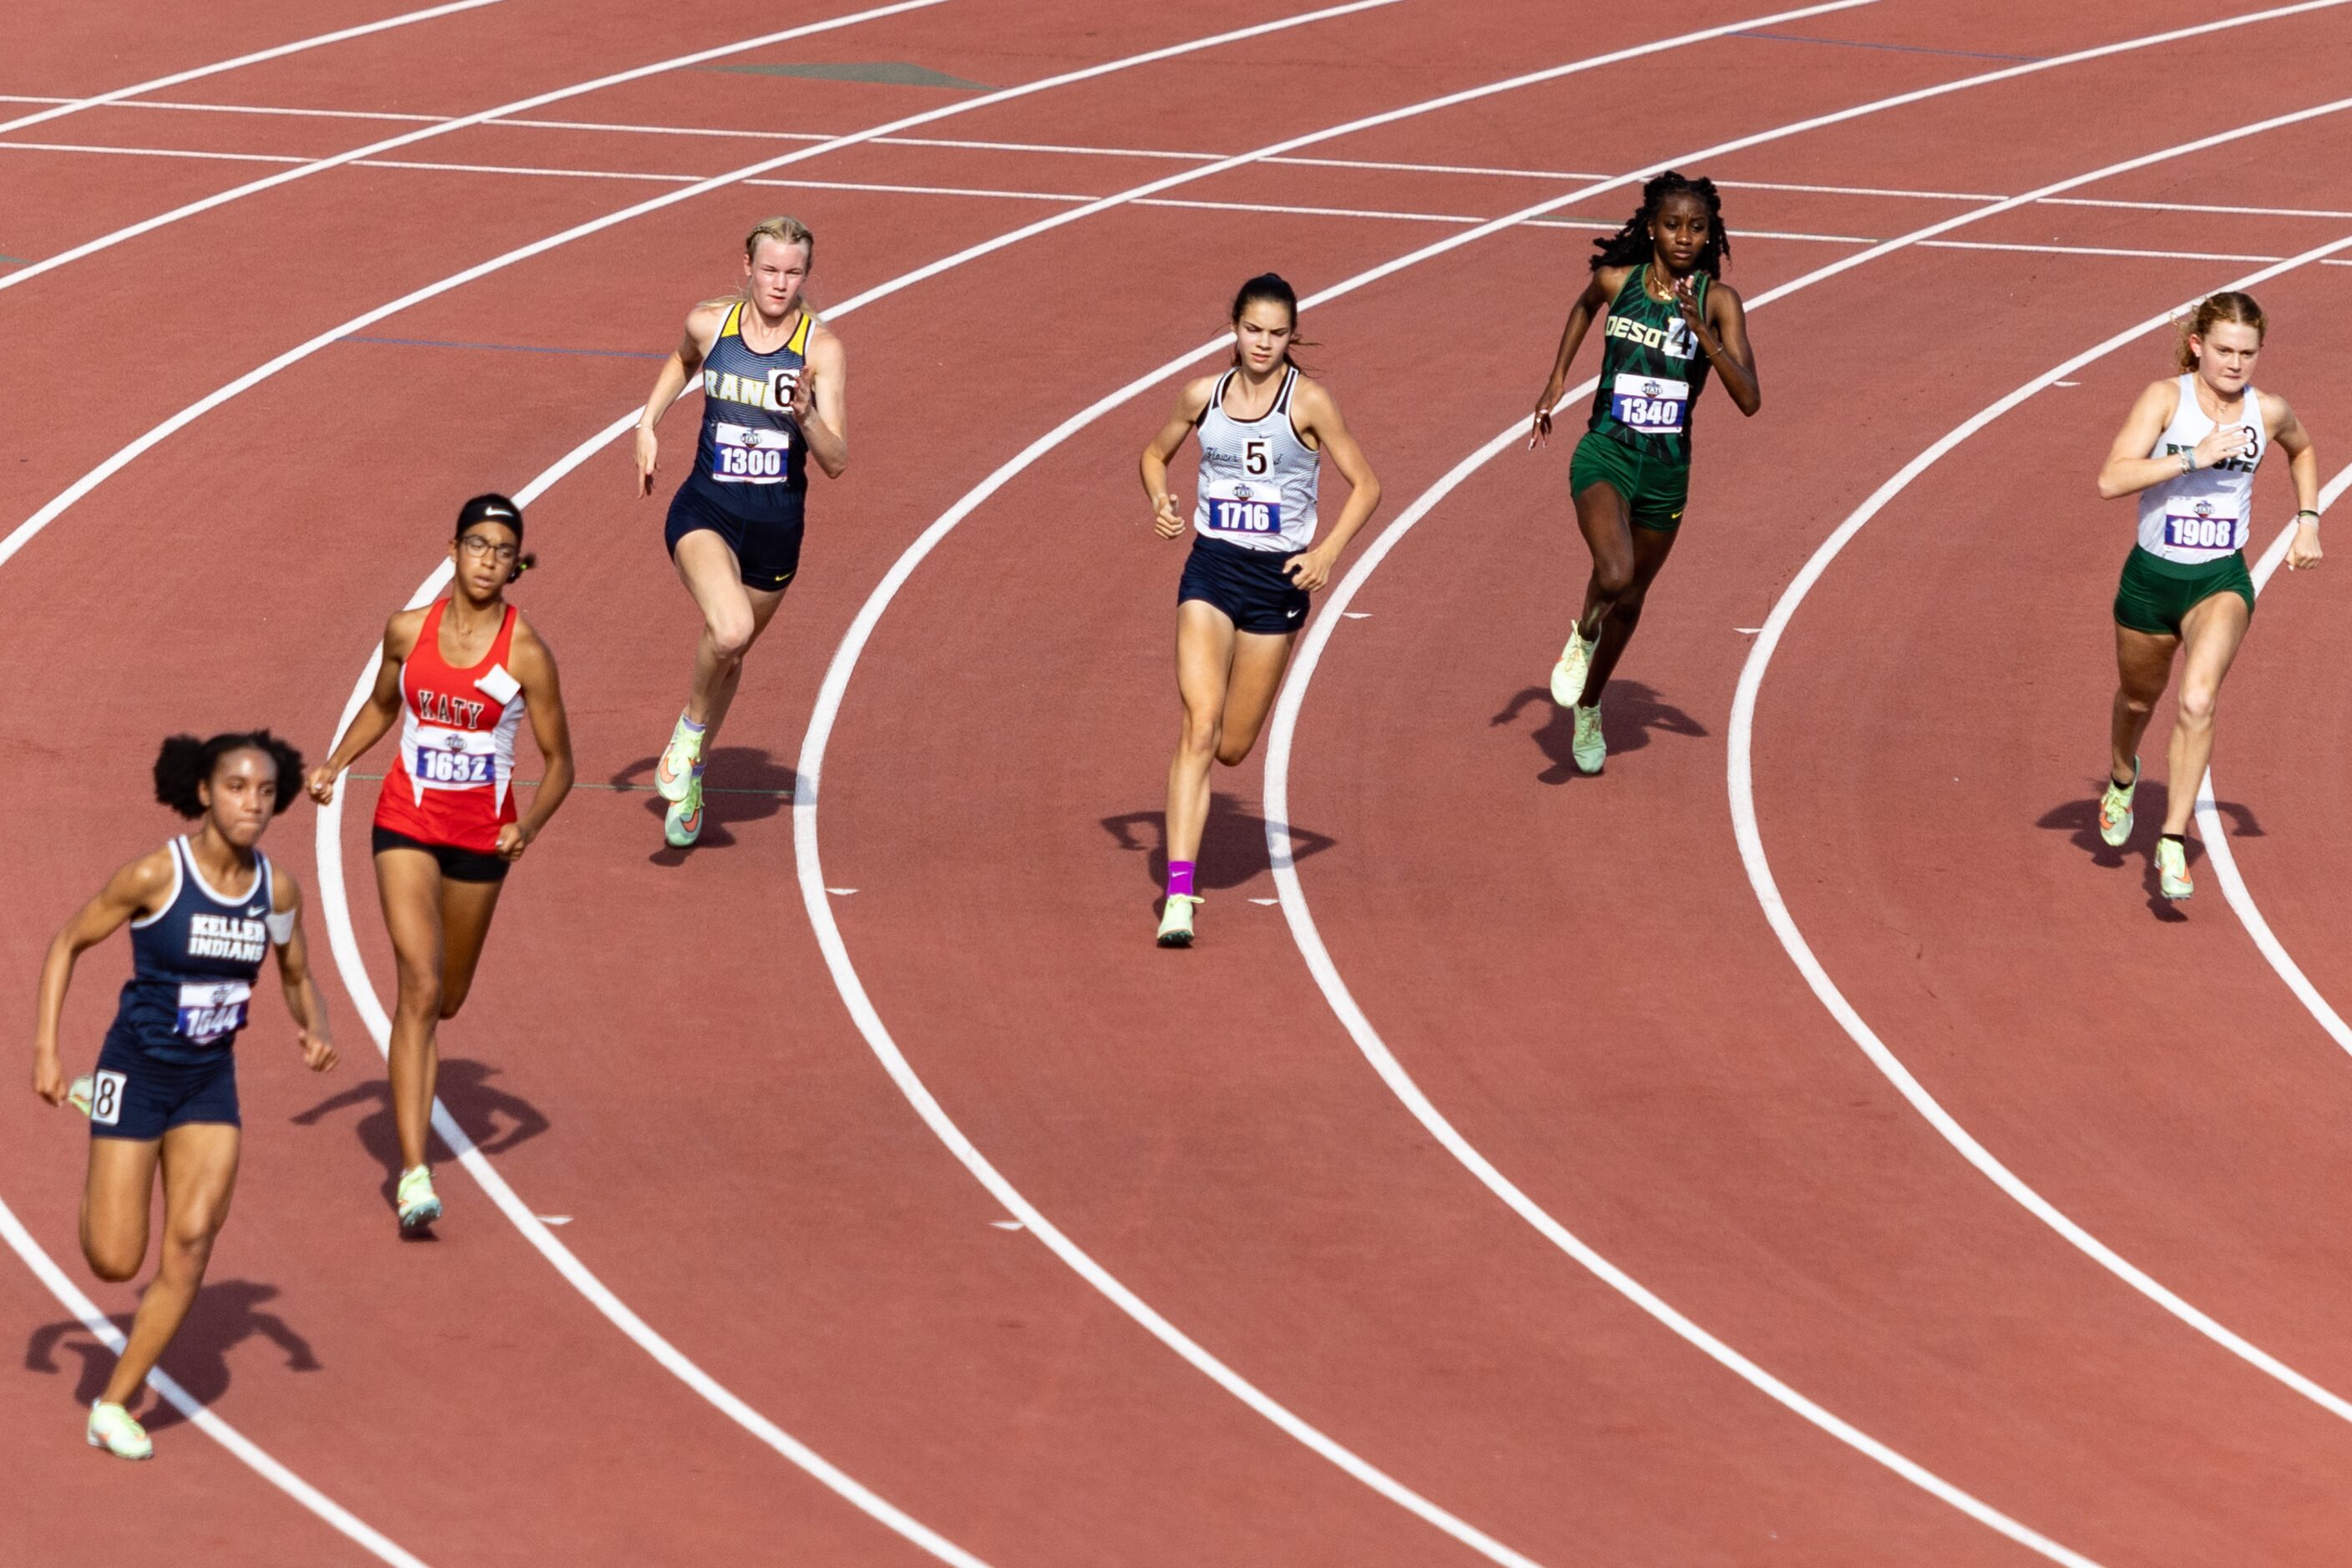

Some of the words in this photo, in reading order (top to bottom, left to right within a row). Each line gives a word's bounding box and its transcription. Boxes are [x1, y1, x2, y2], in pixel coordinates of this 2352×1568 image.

[1605, 316, 1669, 349] DESO
[1671, 323, 1692, 355] 4
[775, 373, 797, 407] 6
[1620, 397, 1678, 425] 1340
[2243, 425, 2258, 459] 3
[721, 447, 781, 476] 1300
[1247, 442, 1267, 475] 5
[1217, 502, 1270, 531] 1716
[2171, 518, 2231, 548] 1908
[418, 689, 485, 730] KATY
[423, 751, 488, 781] 1632
[191, 913, 266, 943] KELLER
[188, 936, 265, 962] INDIANS
[186, 1004, 241, 1037] 1644
[96, 1077, 116, 1119] 8
